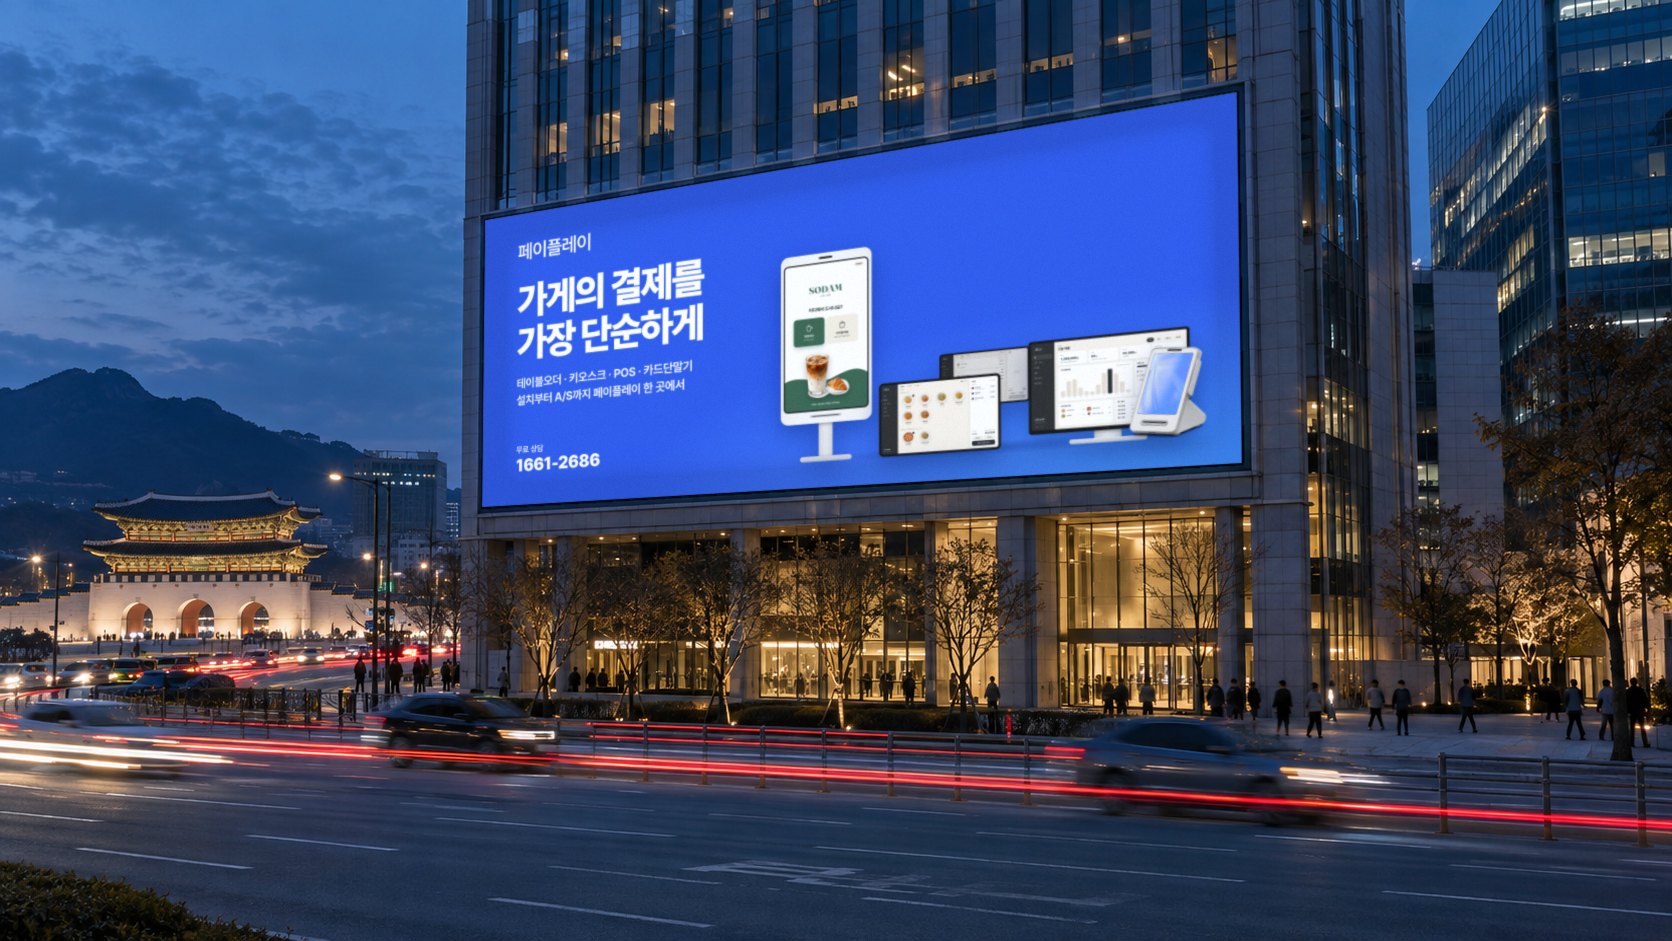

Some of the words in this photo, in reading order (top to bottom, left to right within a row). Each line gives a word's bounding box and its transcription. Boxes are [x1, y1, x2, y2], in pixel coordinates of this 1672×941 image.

[518, 233, 592, 260] 페이플레이
[517, 272, 605, 317] 가게의
[611, 258, 706, 307] 결제를
[808, 283, 843, 295] SODAM
[517, 319, 577, 360] 가장
[581, 302, 704, 354] 단순하게
[516, 373, 562, 389] 테이블오더
[569, 369, 607, 384] 키오스크
[613, 366, 636, 379] POS
[643, 359, 693, 376] 카드단말기
[516, 391, 553, 407] 설치부터
[554, 387, 591, 403] A/S까지
[643, 382, 653, 394] 한
[655, 378, 685, 392] 곳에서
[516, 452, 601, 472] 1661-2686
